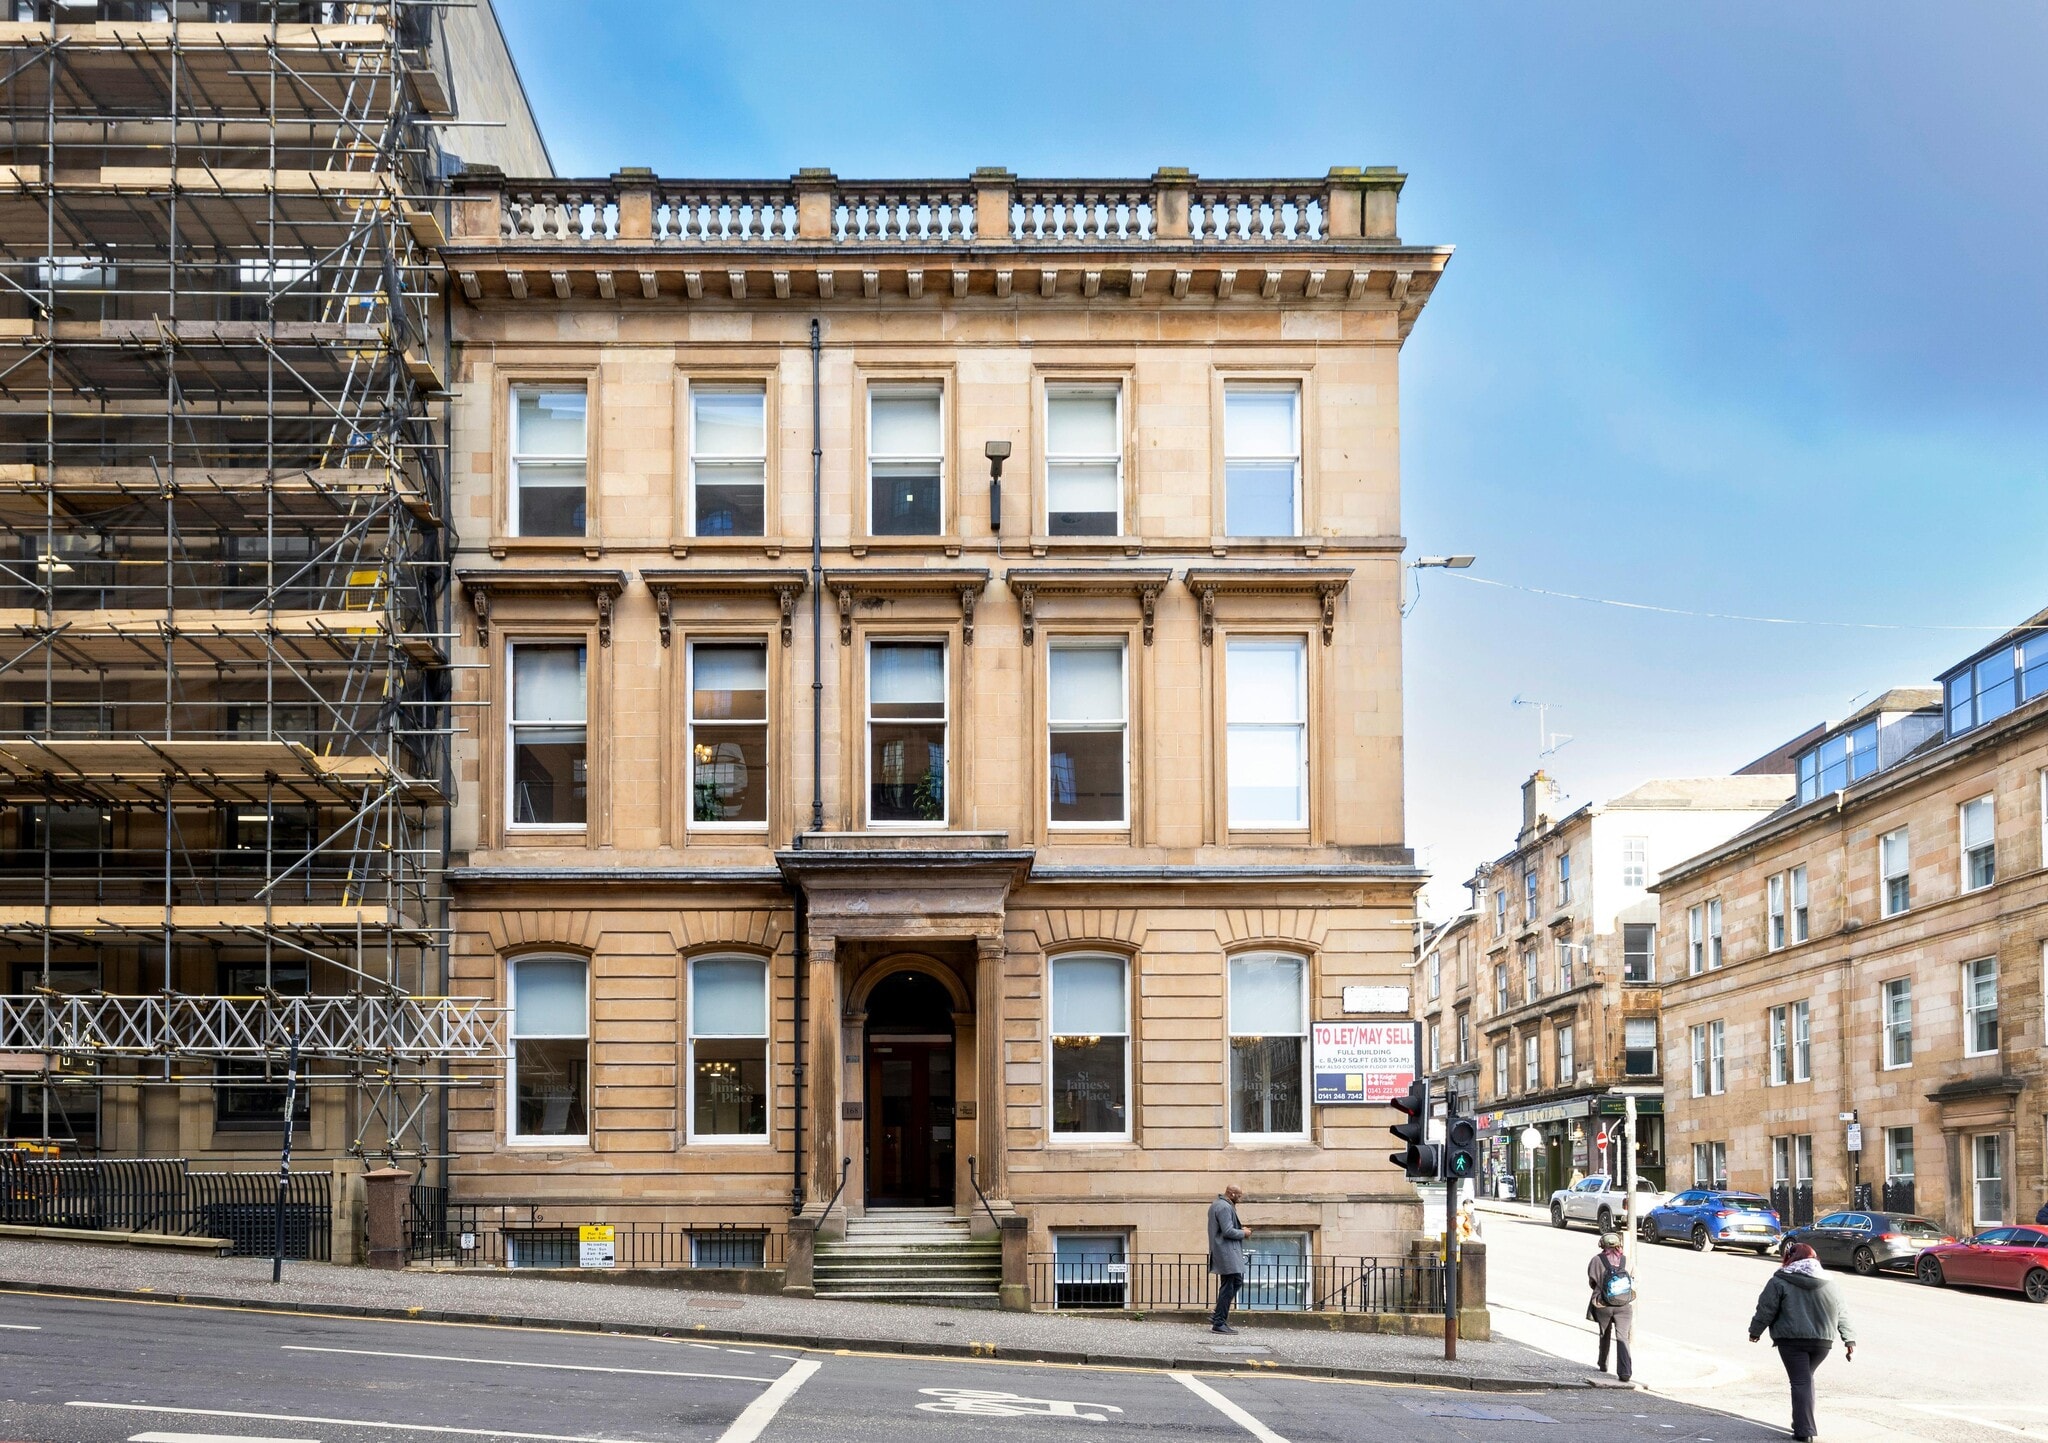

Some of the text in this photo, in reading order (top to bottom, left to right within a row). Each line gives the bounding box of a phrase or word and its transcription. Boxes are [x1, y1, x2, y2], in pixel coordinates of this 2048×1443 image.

[1316, 1027, 1413, 1047] TO LET/MAY SELL
[710, 1083, 754, 1095] James's
[1066, 1080, 1110, 1091] James's
[721, 1093, 754, 1103] Place
[1078, 1090, 1110, 1101] Place
